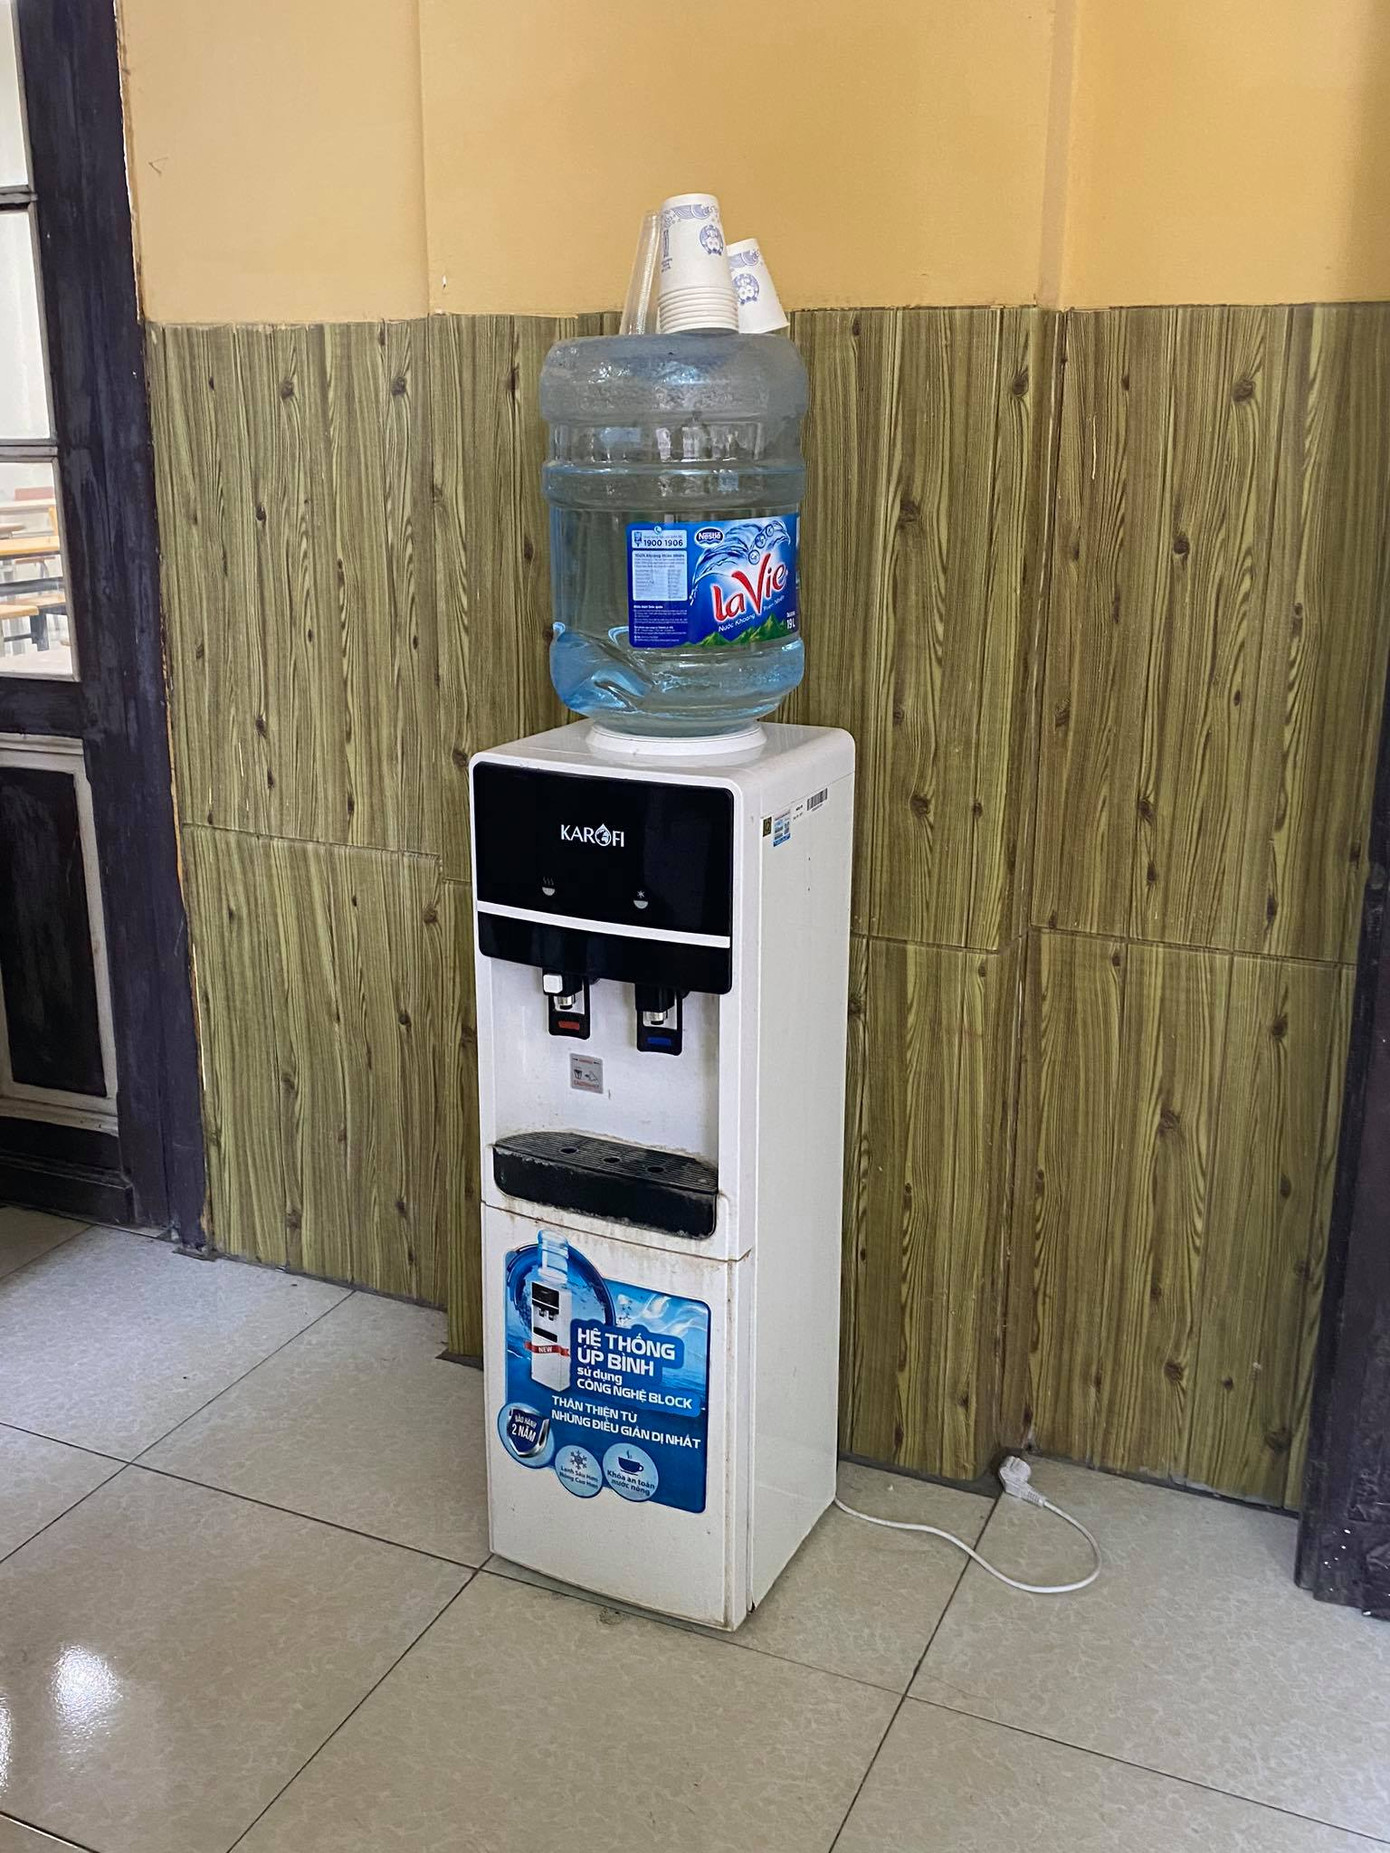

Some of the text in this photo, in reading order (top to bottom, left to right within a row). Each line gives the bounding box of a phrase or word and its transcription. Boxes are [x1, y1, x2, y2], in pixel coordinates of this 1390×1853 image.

[643, 539, 684, 547] 1900 1906
[560, 823, 625, 848] KAROFI
[604, 1332, 676, 1361] THỐNG
[577, 1345, 655, 1377] ÚP BÌNH
[592, 1368, 623, 1386] dụng
[576, 1378, 693, 1410] CÔNG NGHỆ BLOCK
[511, 1423, 517, 1435] 2
[651, 1431, 664, 1444] DỊ
